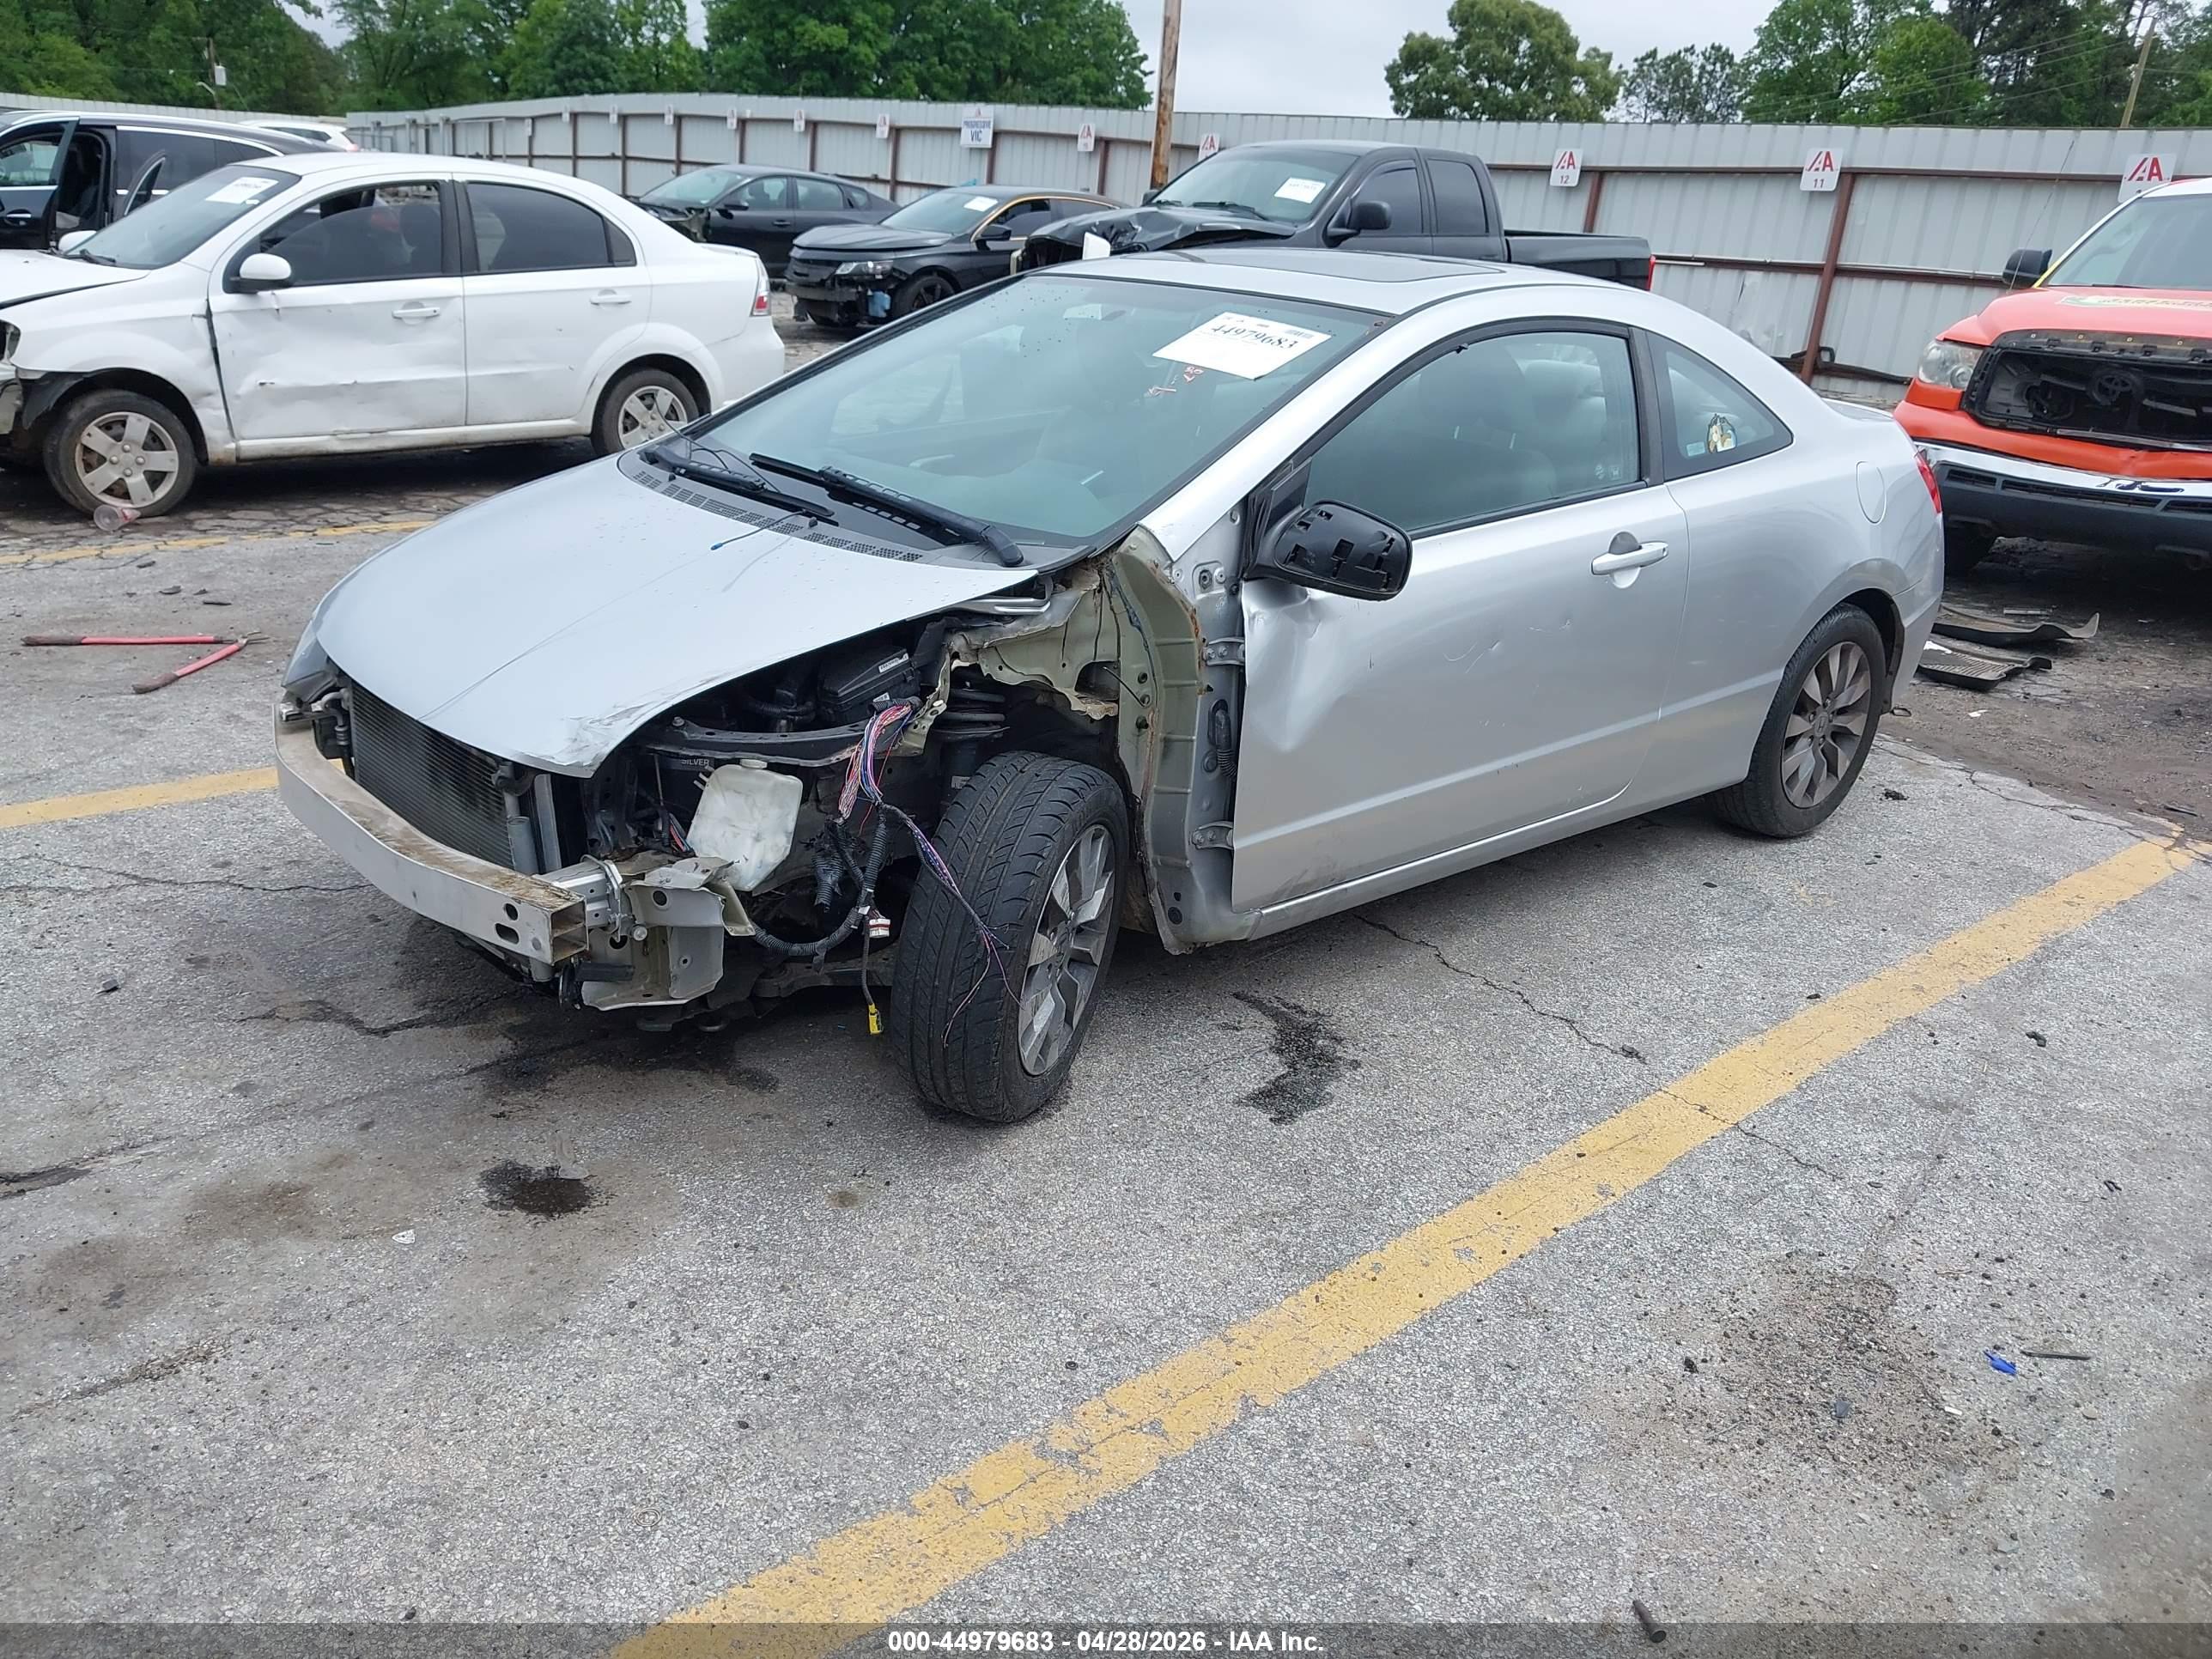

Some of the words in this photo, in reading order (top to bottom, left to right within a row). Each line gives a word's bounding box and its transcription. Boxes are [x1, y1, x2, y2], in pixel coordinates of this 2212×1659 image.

[970, 130, 982, 143] VIC
[1559, 174, 1570, 185] 12
[1813, 178, 1826, 189] 11
